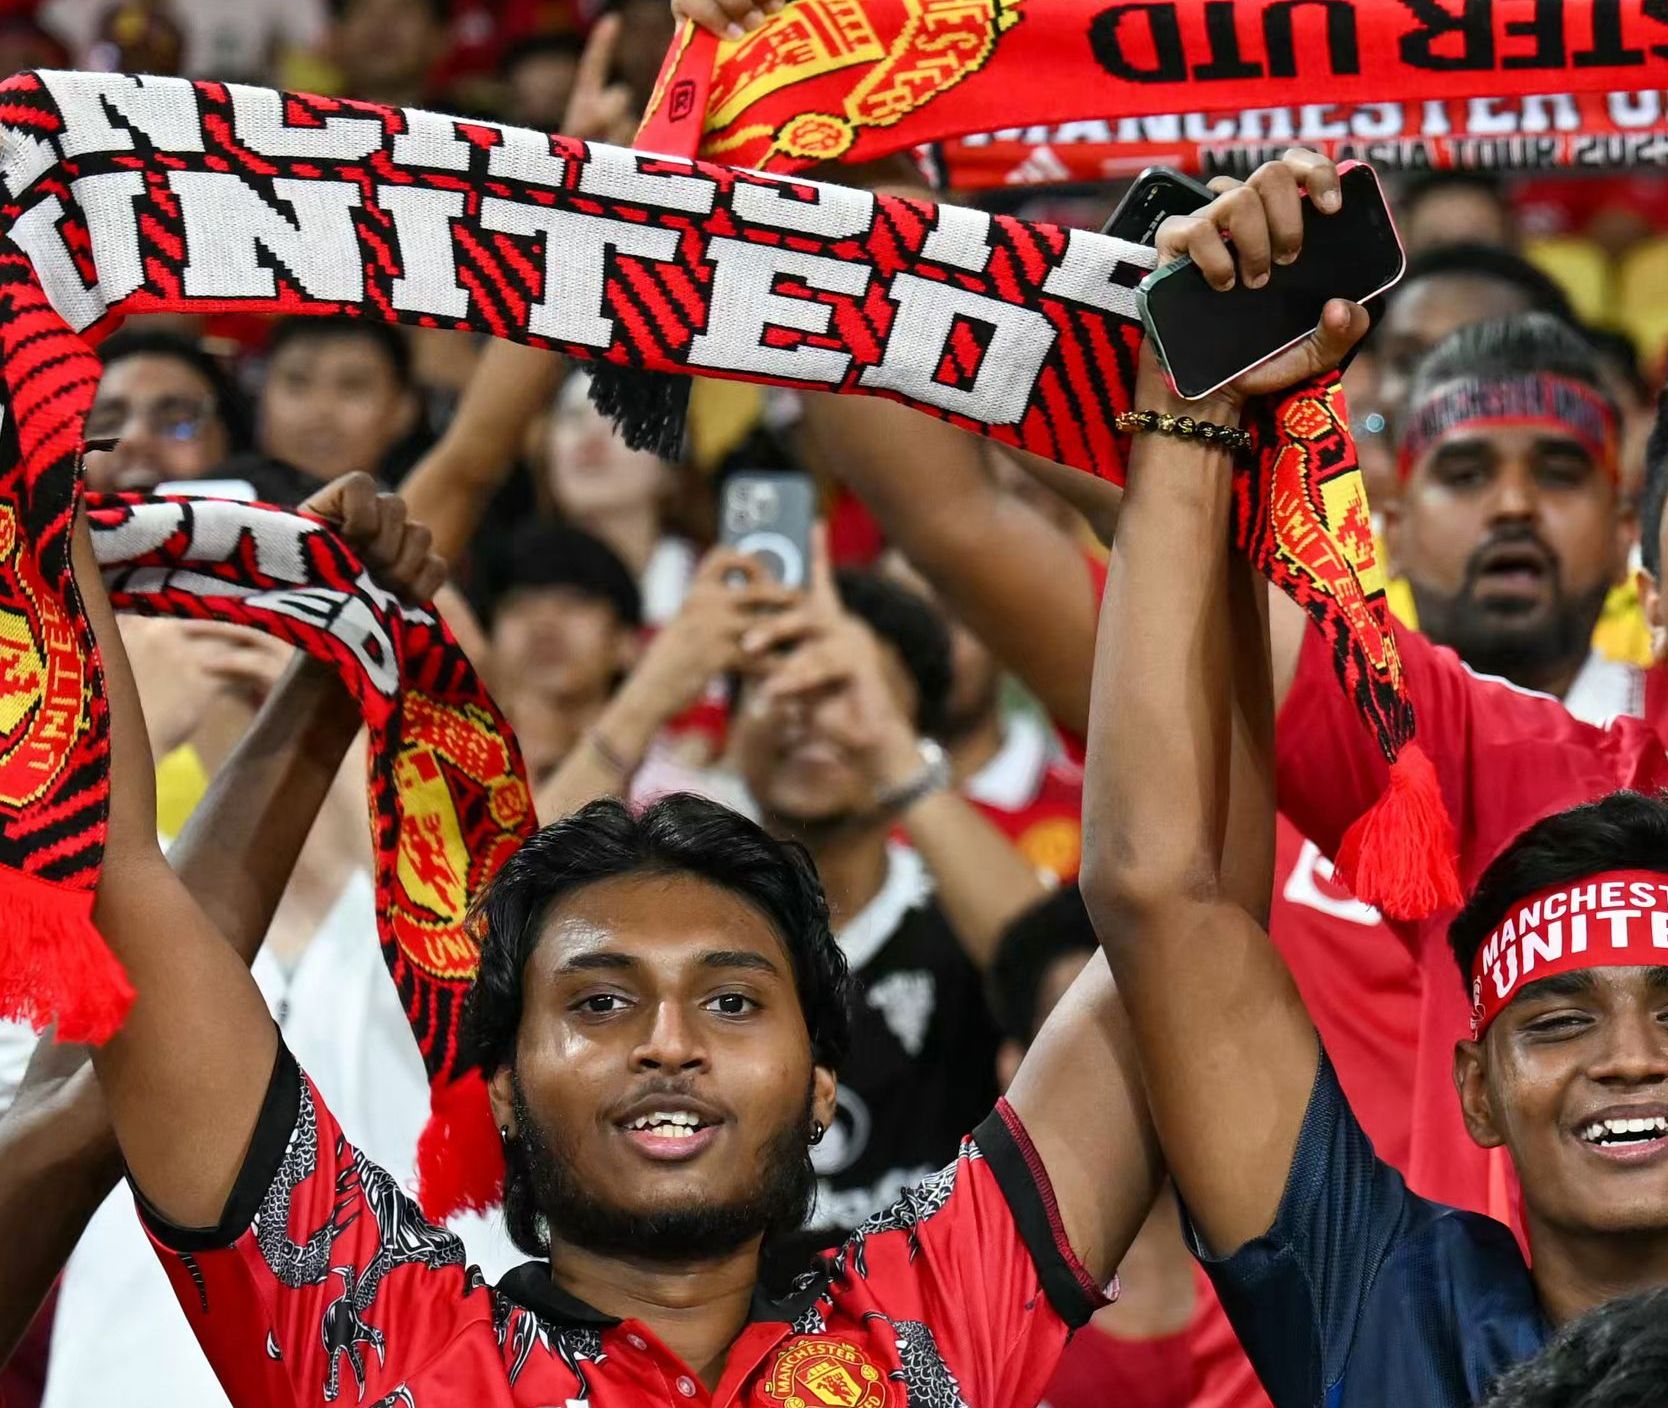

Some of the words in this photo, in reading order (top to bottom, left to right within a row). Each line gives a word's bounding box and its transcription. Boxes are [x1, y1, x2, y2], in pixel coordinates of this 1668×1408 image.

[866, 0, 986, 120] ESTER
[1087, 2, 1360, 83] UTD
[6, 170, 1058, 424] UNITED
[776, 1344, 857, 1393] MANCHESTER
